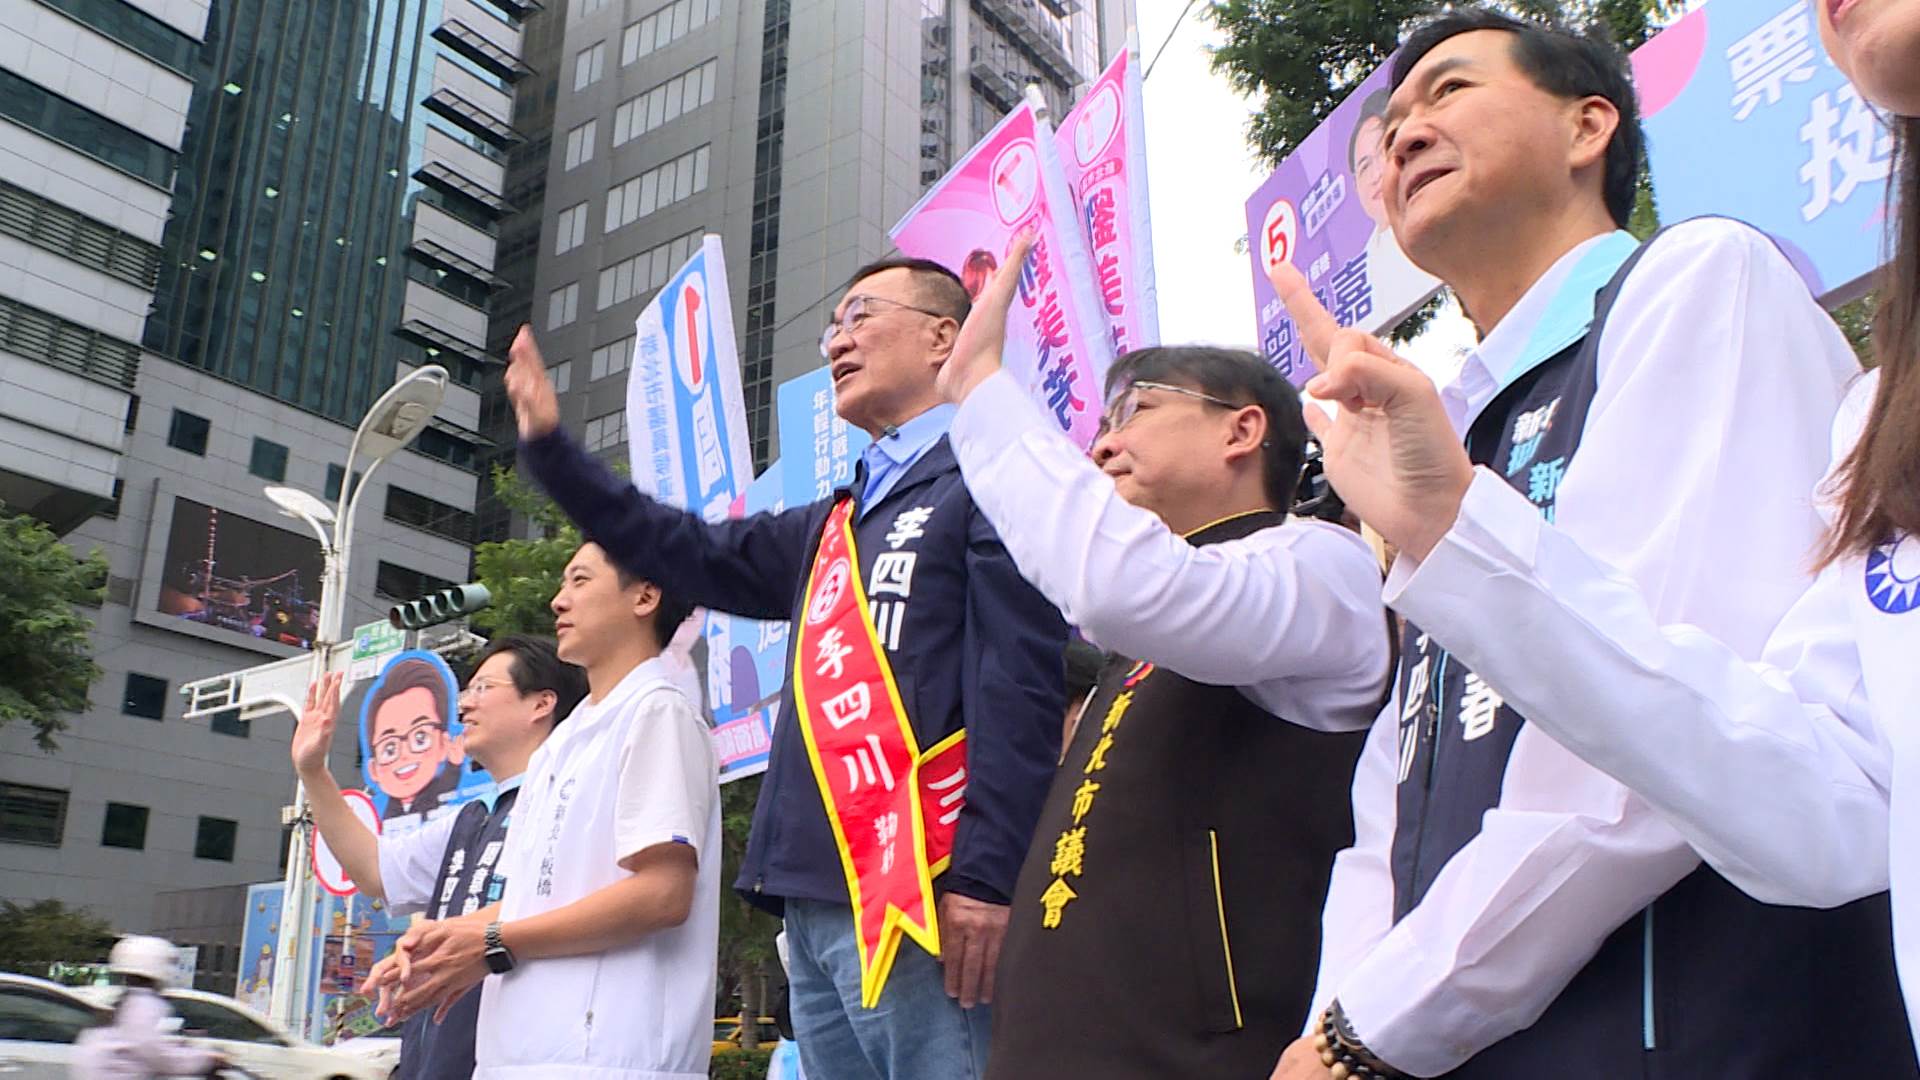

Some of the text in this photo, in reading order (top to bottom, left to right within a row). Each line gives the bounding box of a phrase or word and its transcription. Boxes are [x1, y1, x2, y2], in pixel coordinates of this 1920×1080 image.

[1727, 0, 1817, 121] 票
[1267, 214, 1289, 266] 5
[1264, 250, 1374, 377] 曾嘉
[868, 506, 936, 651] 李四川
[814, 626, 896, 793] 李四川
[1040, 690, 1135, 929] 新北市議會
